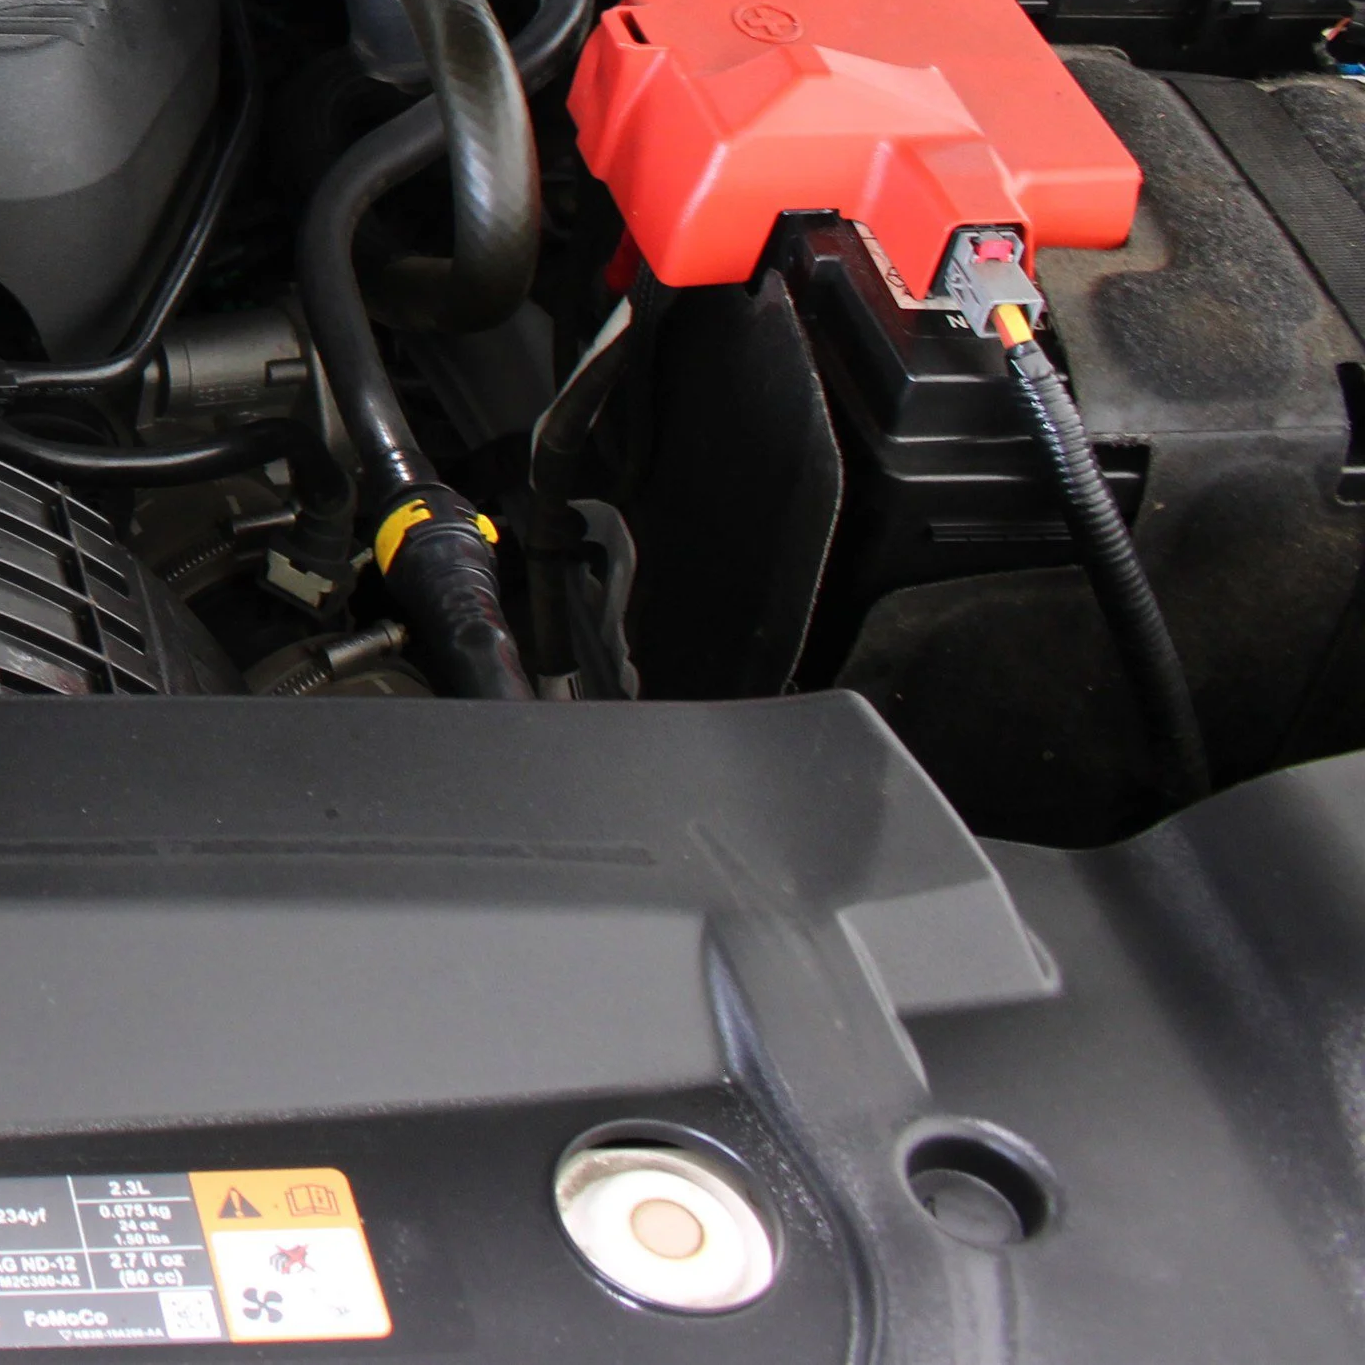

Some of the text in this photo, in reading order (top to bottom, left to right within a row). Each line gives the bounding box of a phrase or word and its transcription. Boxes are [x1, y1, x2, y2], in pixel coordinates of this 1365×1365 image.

[108, 1180, 151, 1196] 2.3L
[147, 1203, 172, 1220] kg
[20, 1255, 78, 1272] ND-12
[109, 1252, 138, 1269] 2.7
[159, 1253, 186, 1268] oz
[152, 1268, 184, 1287] cc)
[22, 1307, 110, 1328] FoMoCo
